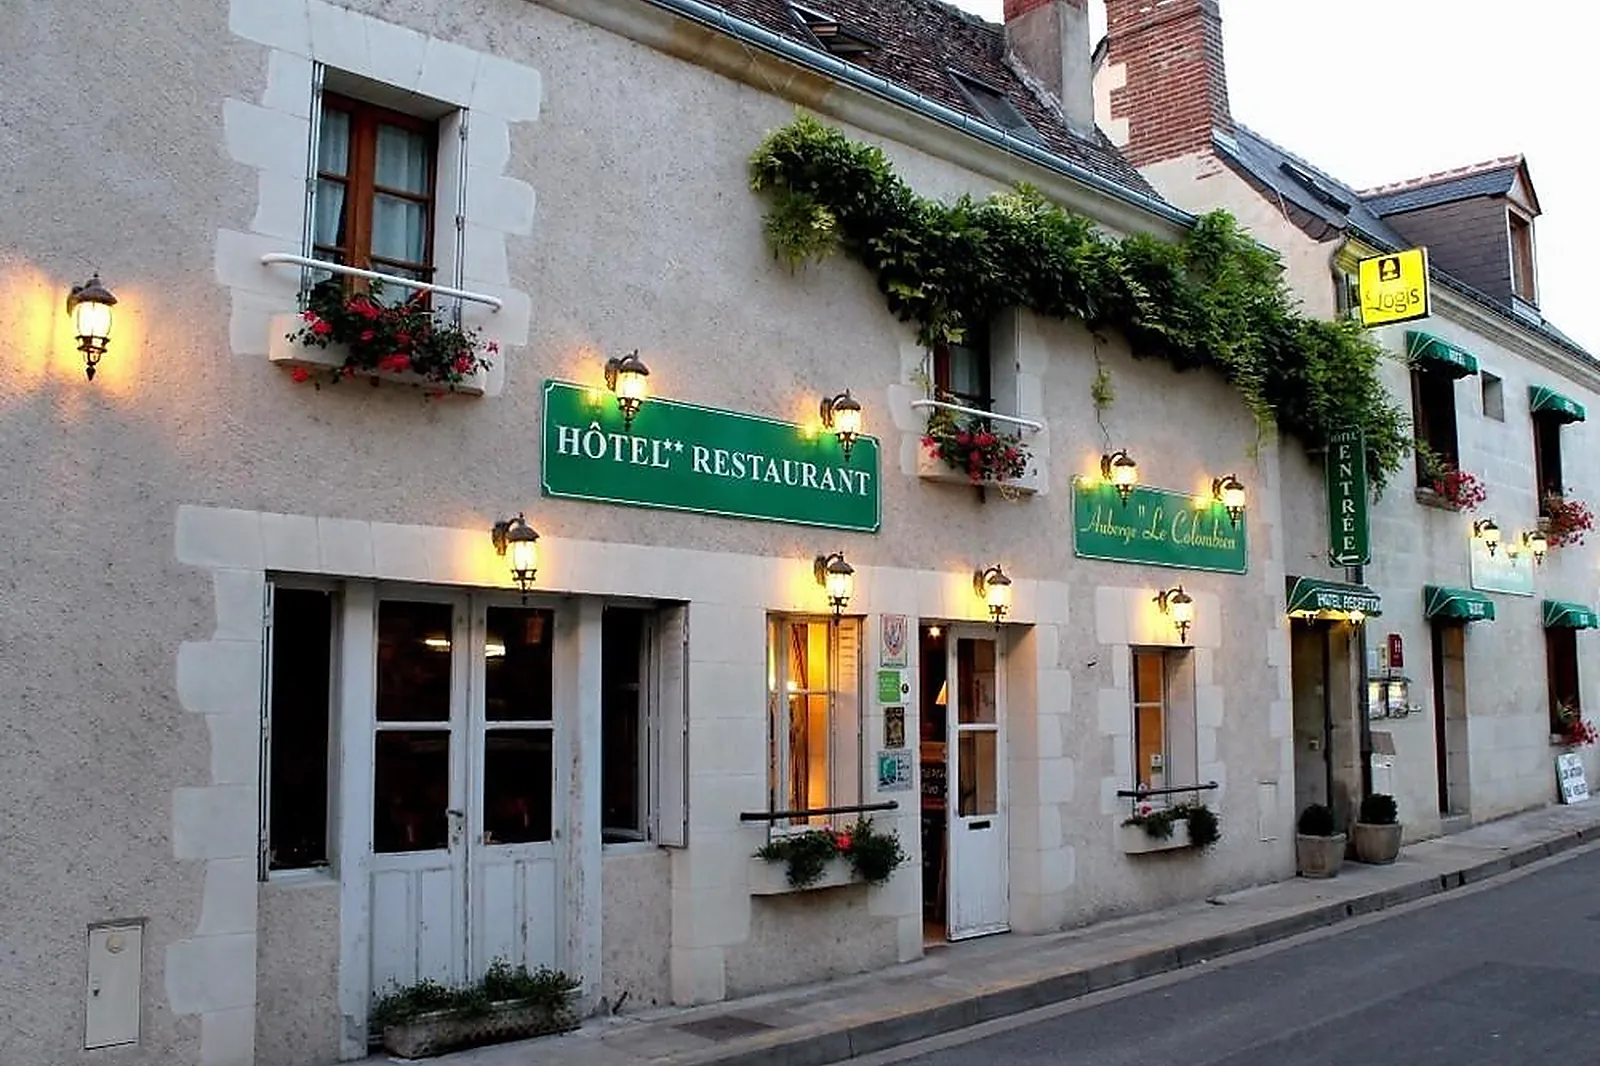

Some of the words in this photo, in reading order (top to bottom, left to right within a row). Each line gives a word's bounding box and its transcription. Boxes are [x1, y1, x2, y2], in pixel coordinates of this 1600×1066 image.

[692, 445, 871, 496] RESTAURANT
[1339, 445, 1355, 550] ENTRÉE
[1080, 504, 1137, 545] Auberge
